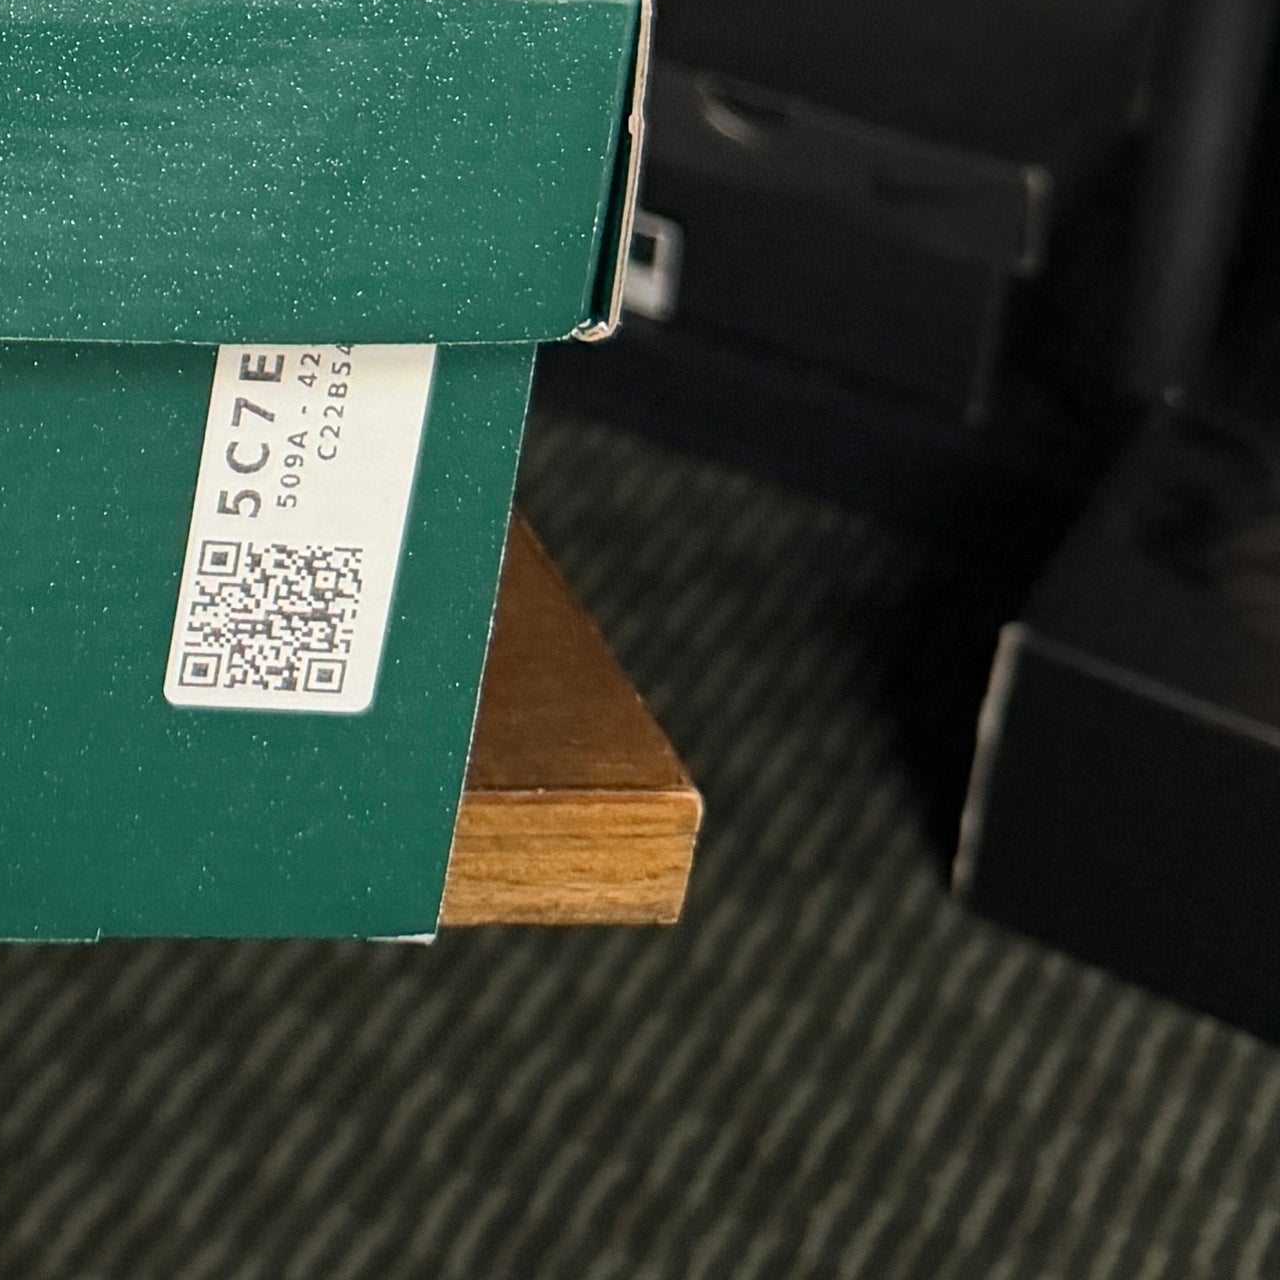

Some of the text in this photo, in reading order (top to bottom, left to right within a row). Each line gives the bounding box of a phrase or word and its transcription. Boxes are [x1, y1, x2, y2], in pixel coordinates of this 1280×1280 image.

[217, 353, 285, 519] 5C7E
[277, 430, 309, 508] 509A
[297, 352, 320, 388] 42
